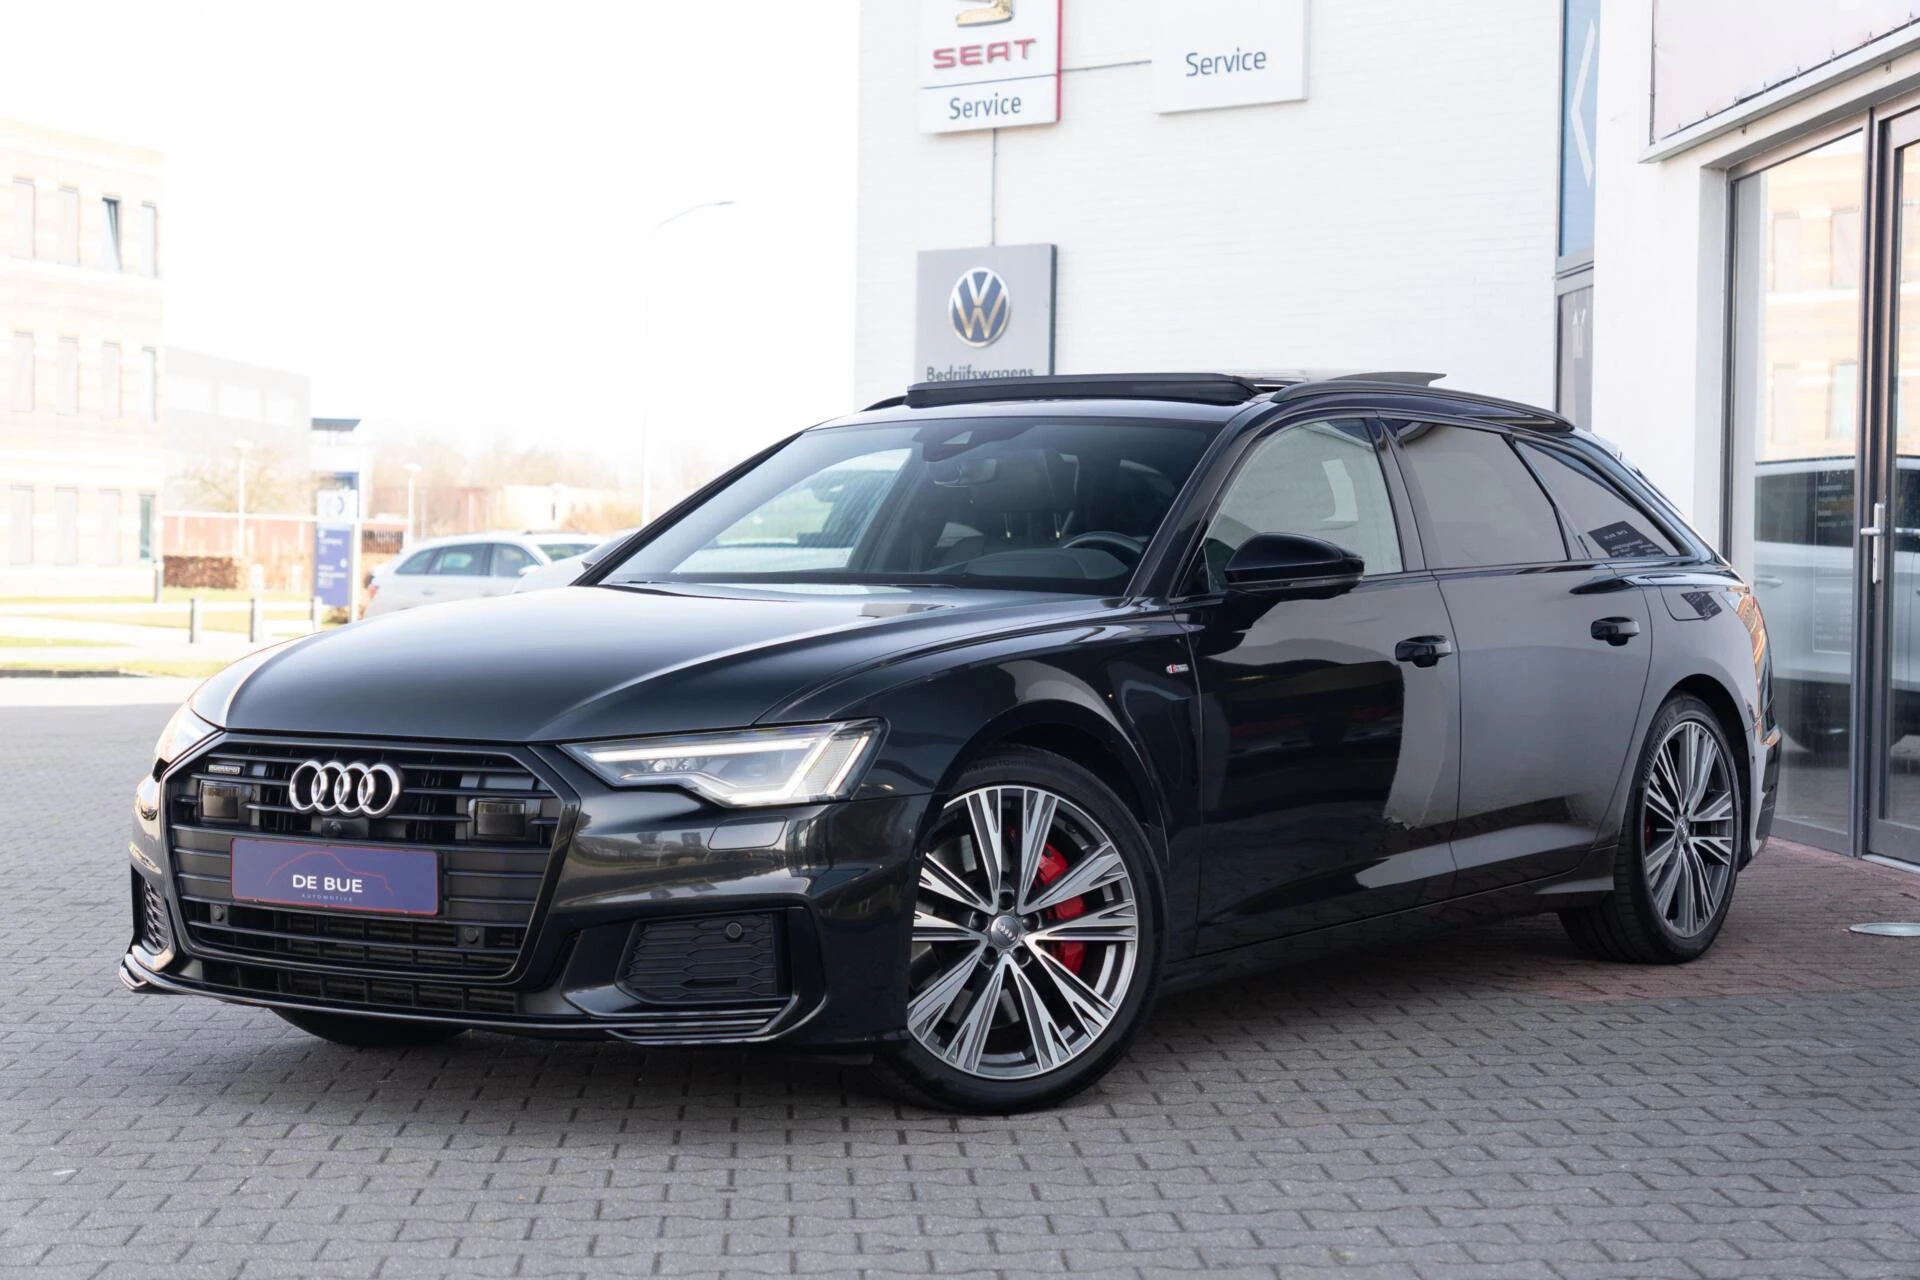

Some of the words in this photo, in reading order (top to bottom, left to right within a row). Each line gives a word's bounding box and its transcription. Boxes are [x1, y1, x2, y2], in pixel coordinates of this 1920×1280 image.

[933, 38, 1037, 69] SEAT
[1185, 46, 1266, 77] Service
[949, 91, 1022, 120] Service
[292, 874, 318, 890] DE
[324, 876, 363, 893] BUE
